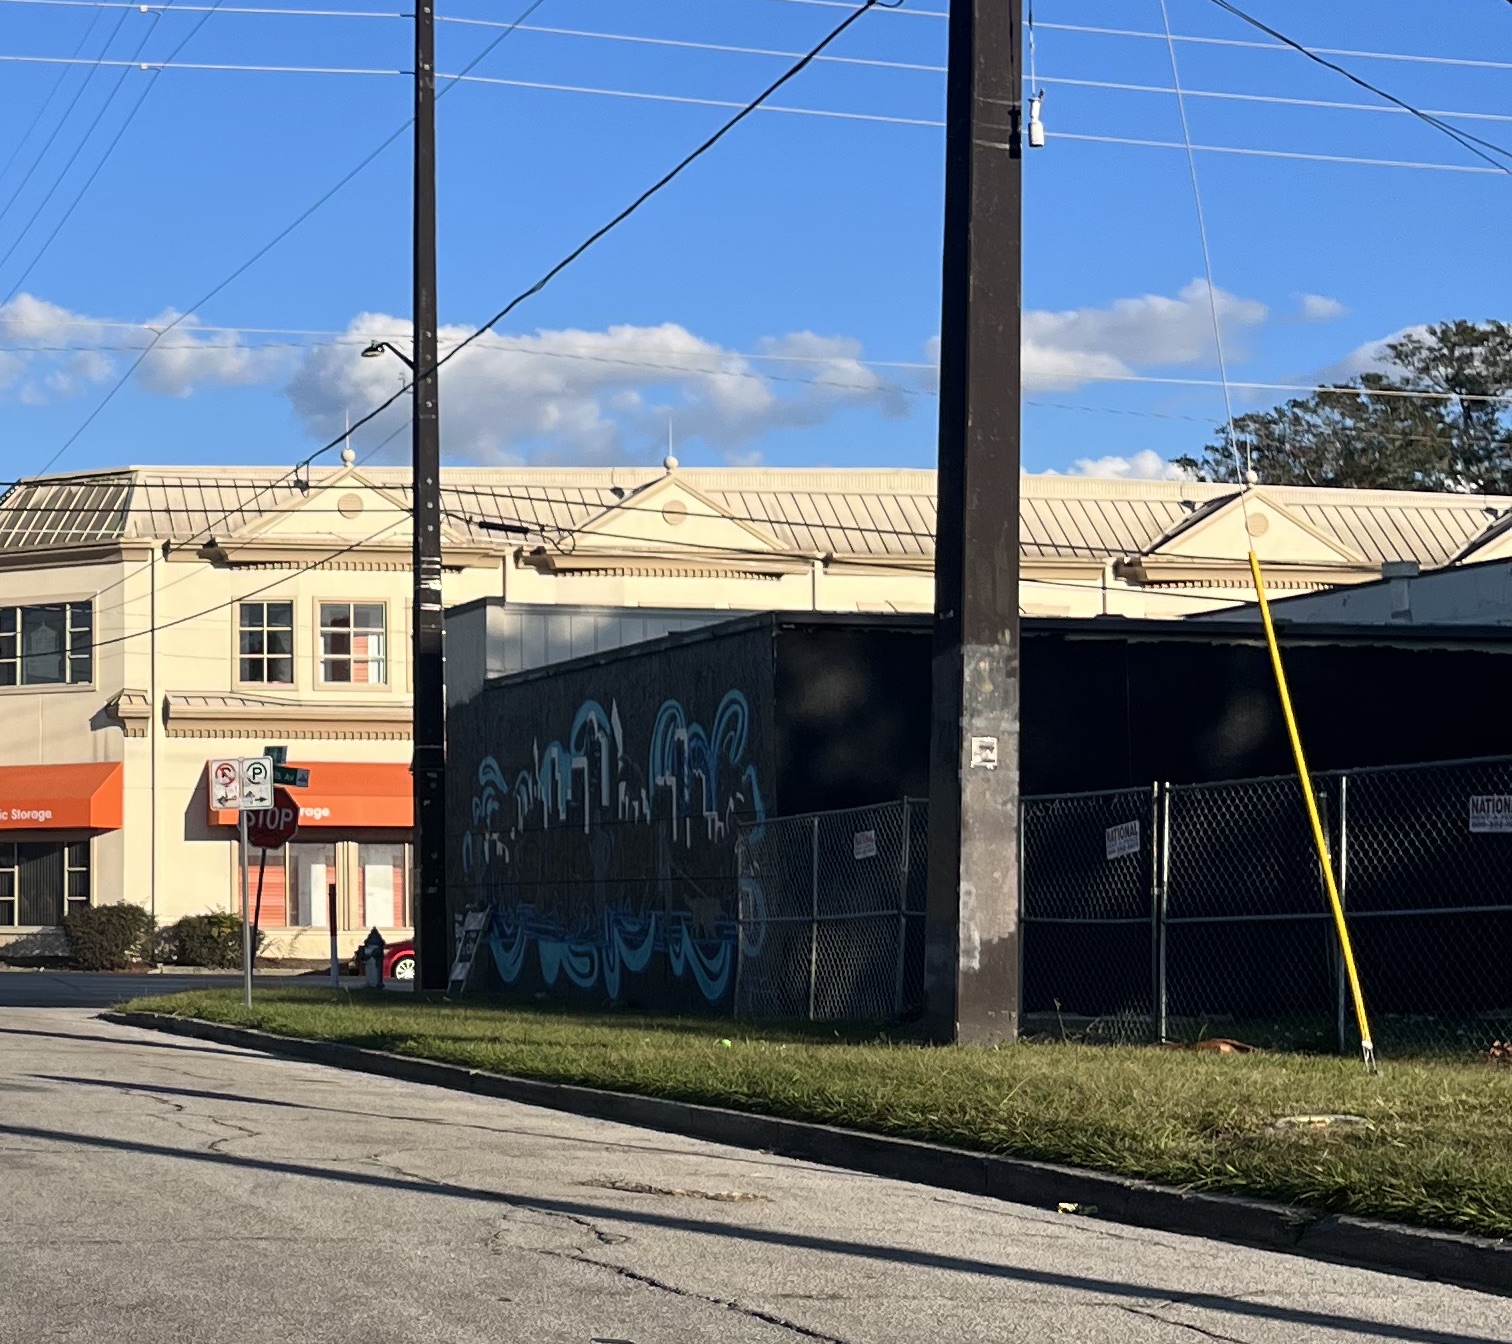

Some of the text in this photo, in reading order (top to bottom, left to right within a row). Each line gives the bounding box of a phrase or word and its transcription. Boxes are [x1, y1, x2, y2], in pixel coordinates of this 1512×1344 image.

[299, 807, 330, 820] rage
[1472, 797, 1512, 814] NATION
[11, 808, 52, 822] Storage
[246, 806, 293, 831] STOP
[1106, 822, 1139, 843] NATIONAL
